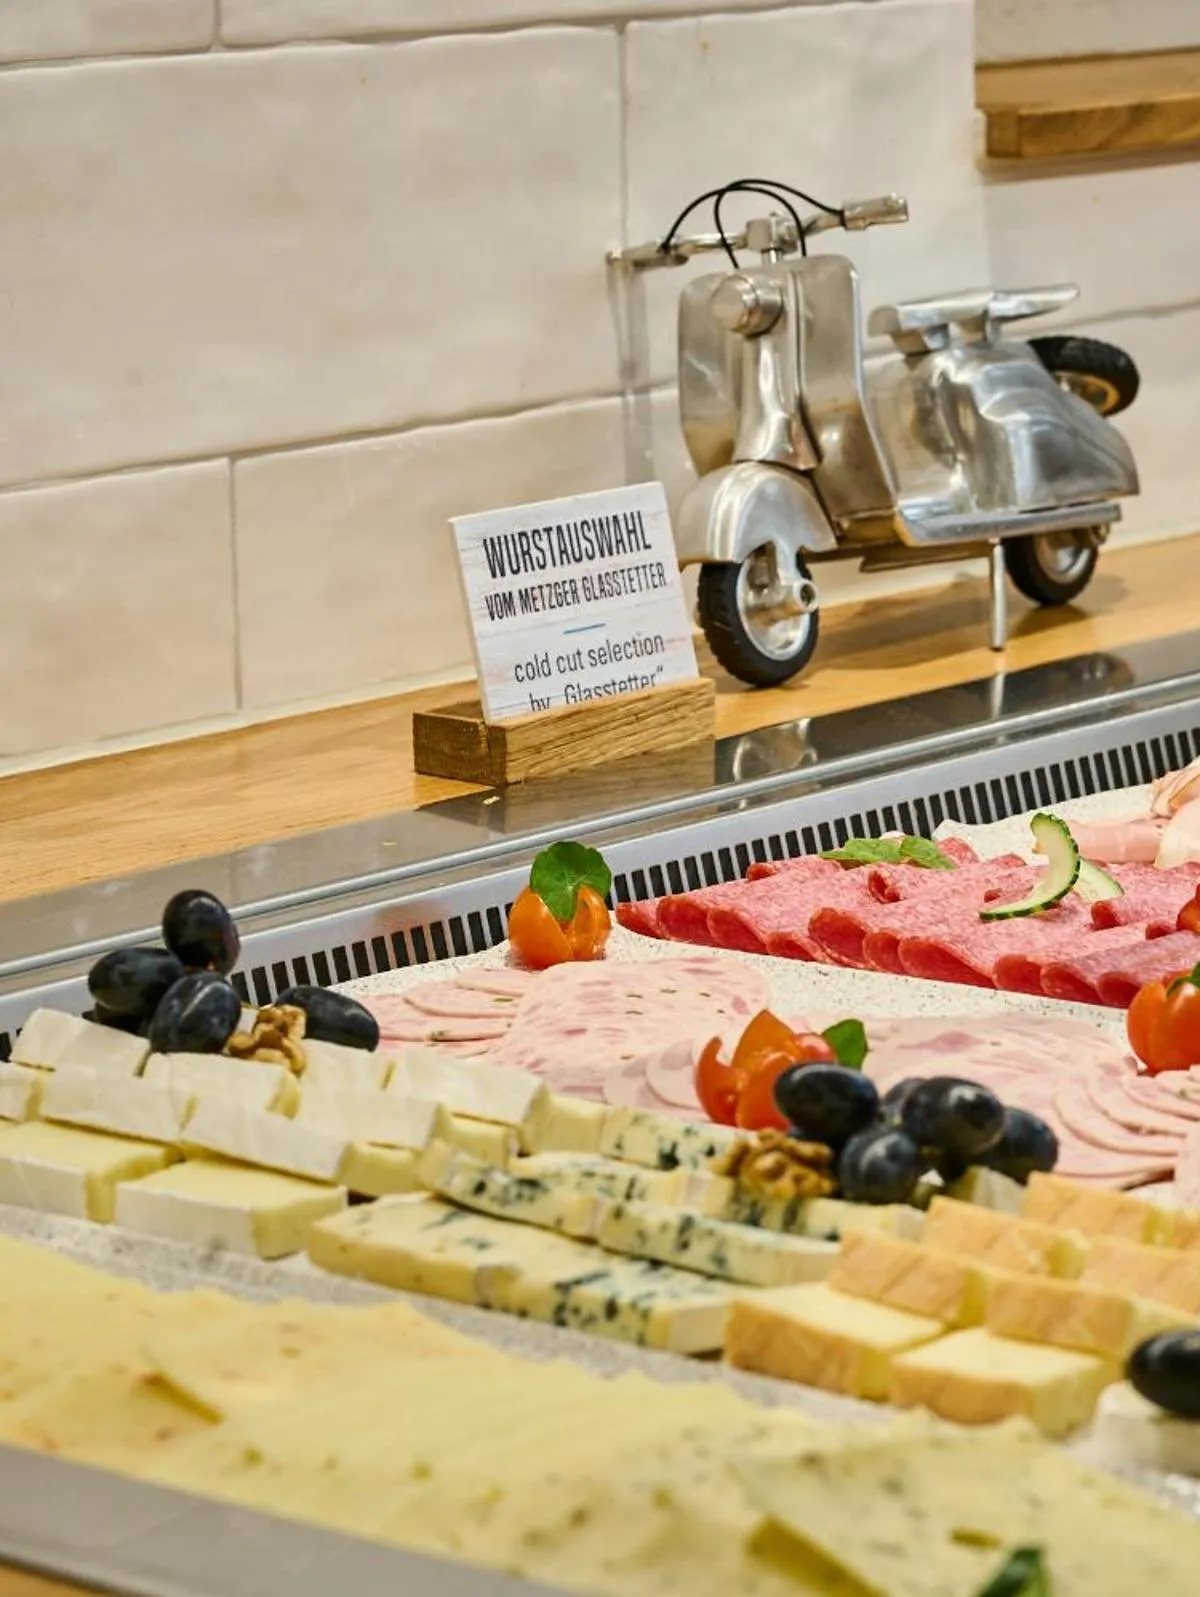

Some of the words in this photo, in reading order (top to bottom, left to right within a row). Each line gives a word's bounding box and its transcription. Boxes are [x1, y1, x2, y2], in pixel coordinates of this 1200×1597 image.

[482, 510, 652, 579] WURSTAUSWAHL
[484, 591, 517, 621] VOM
[518, 578, 581, 614] METZGER
[582, 562, 667, 603] GLASSTETTER
[514, 652, 552, 683] cold
[556, 650, 585, 674] cut
[588, 632, 665, 668] selection
